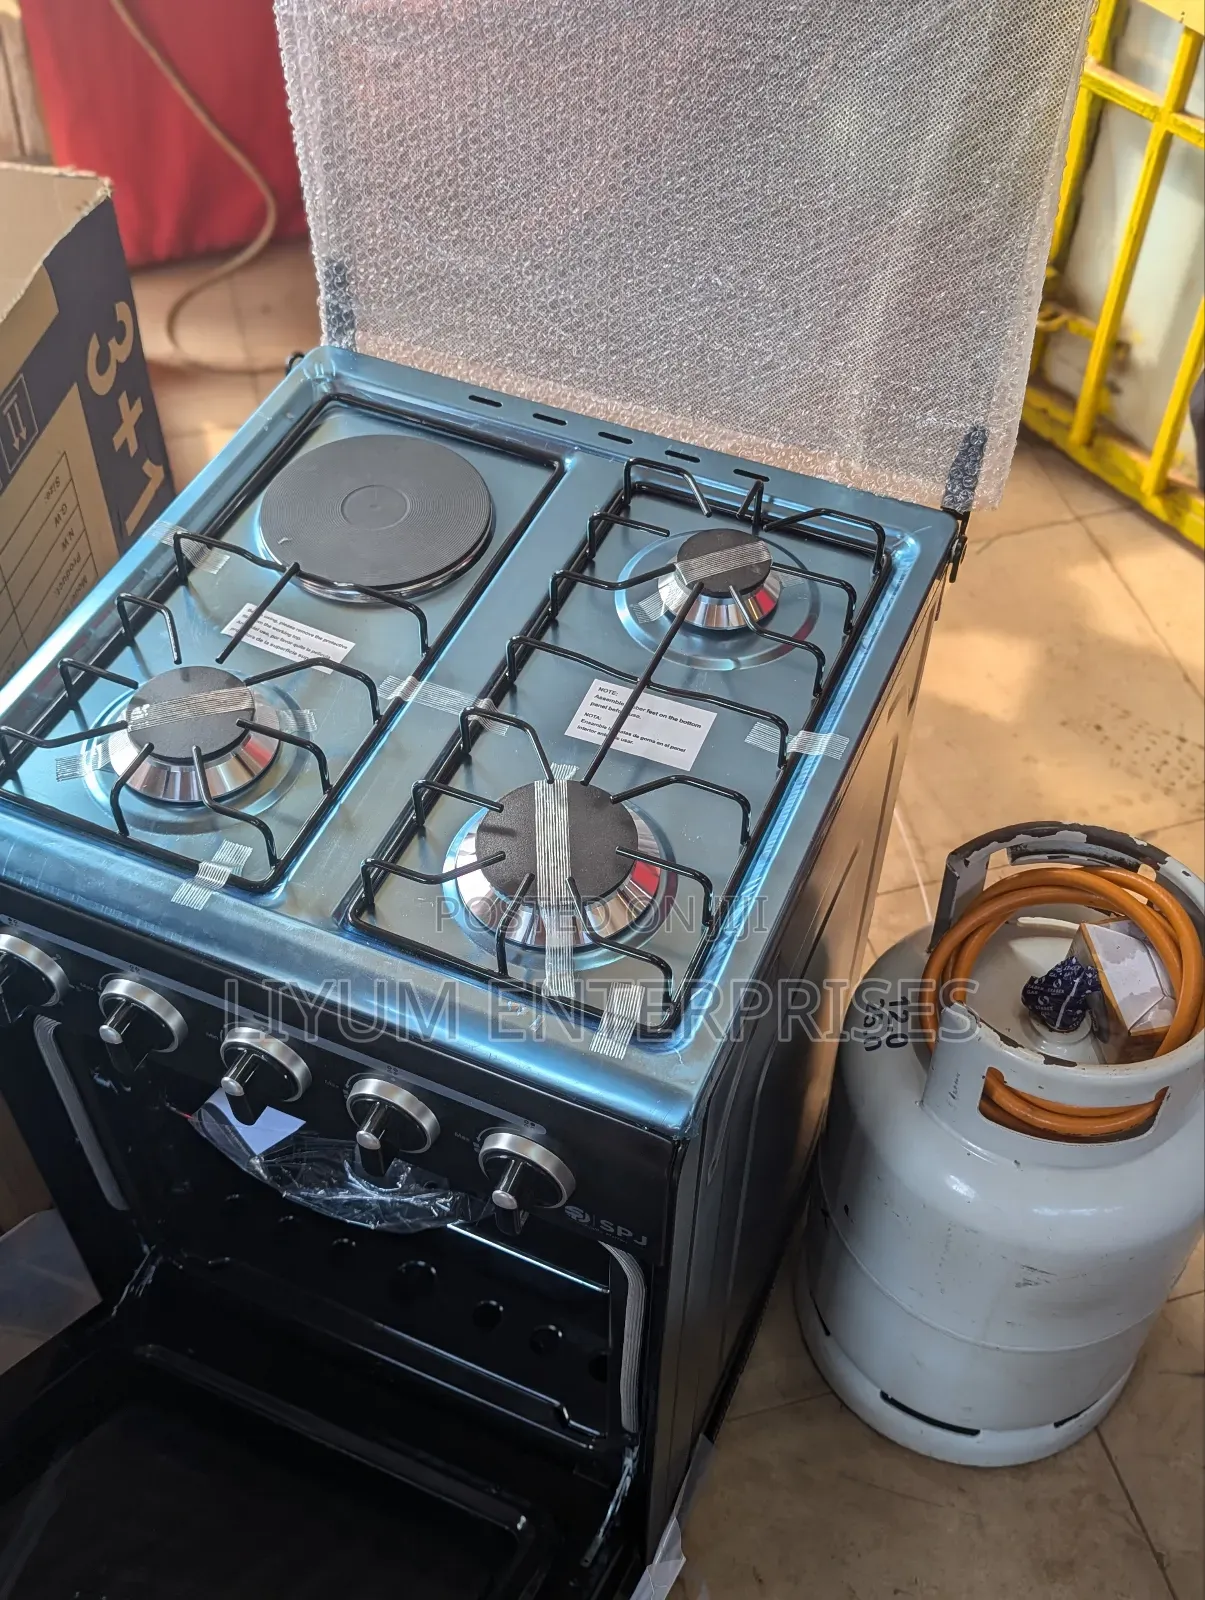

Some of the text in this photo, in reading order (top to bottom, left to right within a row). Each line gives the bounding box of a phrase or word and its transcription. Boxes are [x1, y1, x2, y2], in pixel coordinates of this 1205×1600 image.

[86, 301, 164, 537] 3+1
[272, 626, 292, 638] working
[278, 621, 296, 630] please
[296, 628, 314, 637] remove
[322, 638, 348, 650] protective
[280, 637, 294, 645] favor
[270, 643, 298, 656] superficie
[598, 686, 618, 697] NOTE:
[590, 702, 608, 710] panel
[594, 694, 624, 706] Assemble
[646, 708, 659, 716] feet
[678, 718, 702, 729] bottom
[583, 712, 602, 721] NOTA:
[580, 718, 608, 730] Ensamble
[670, 745, 686, 753] panel
[600, 1219, 648, 1246] SPJ
